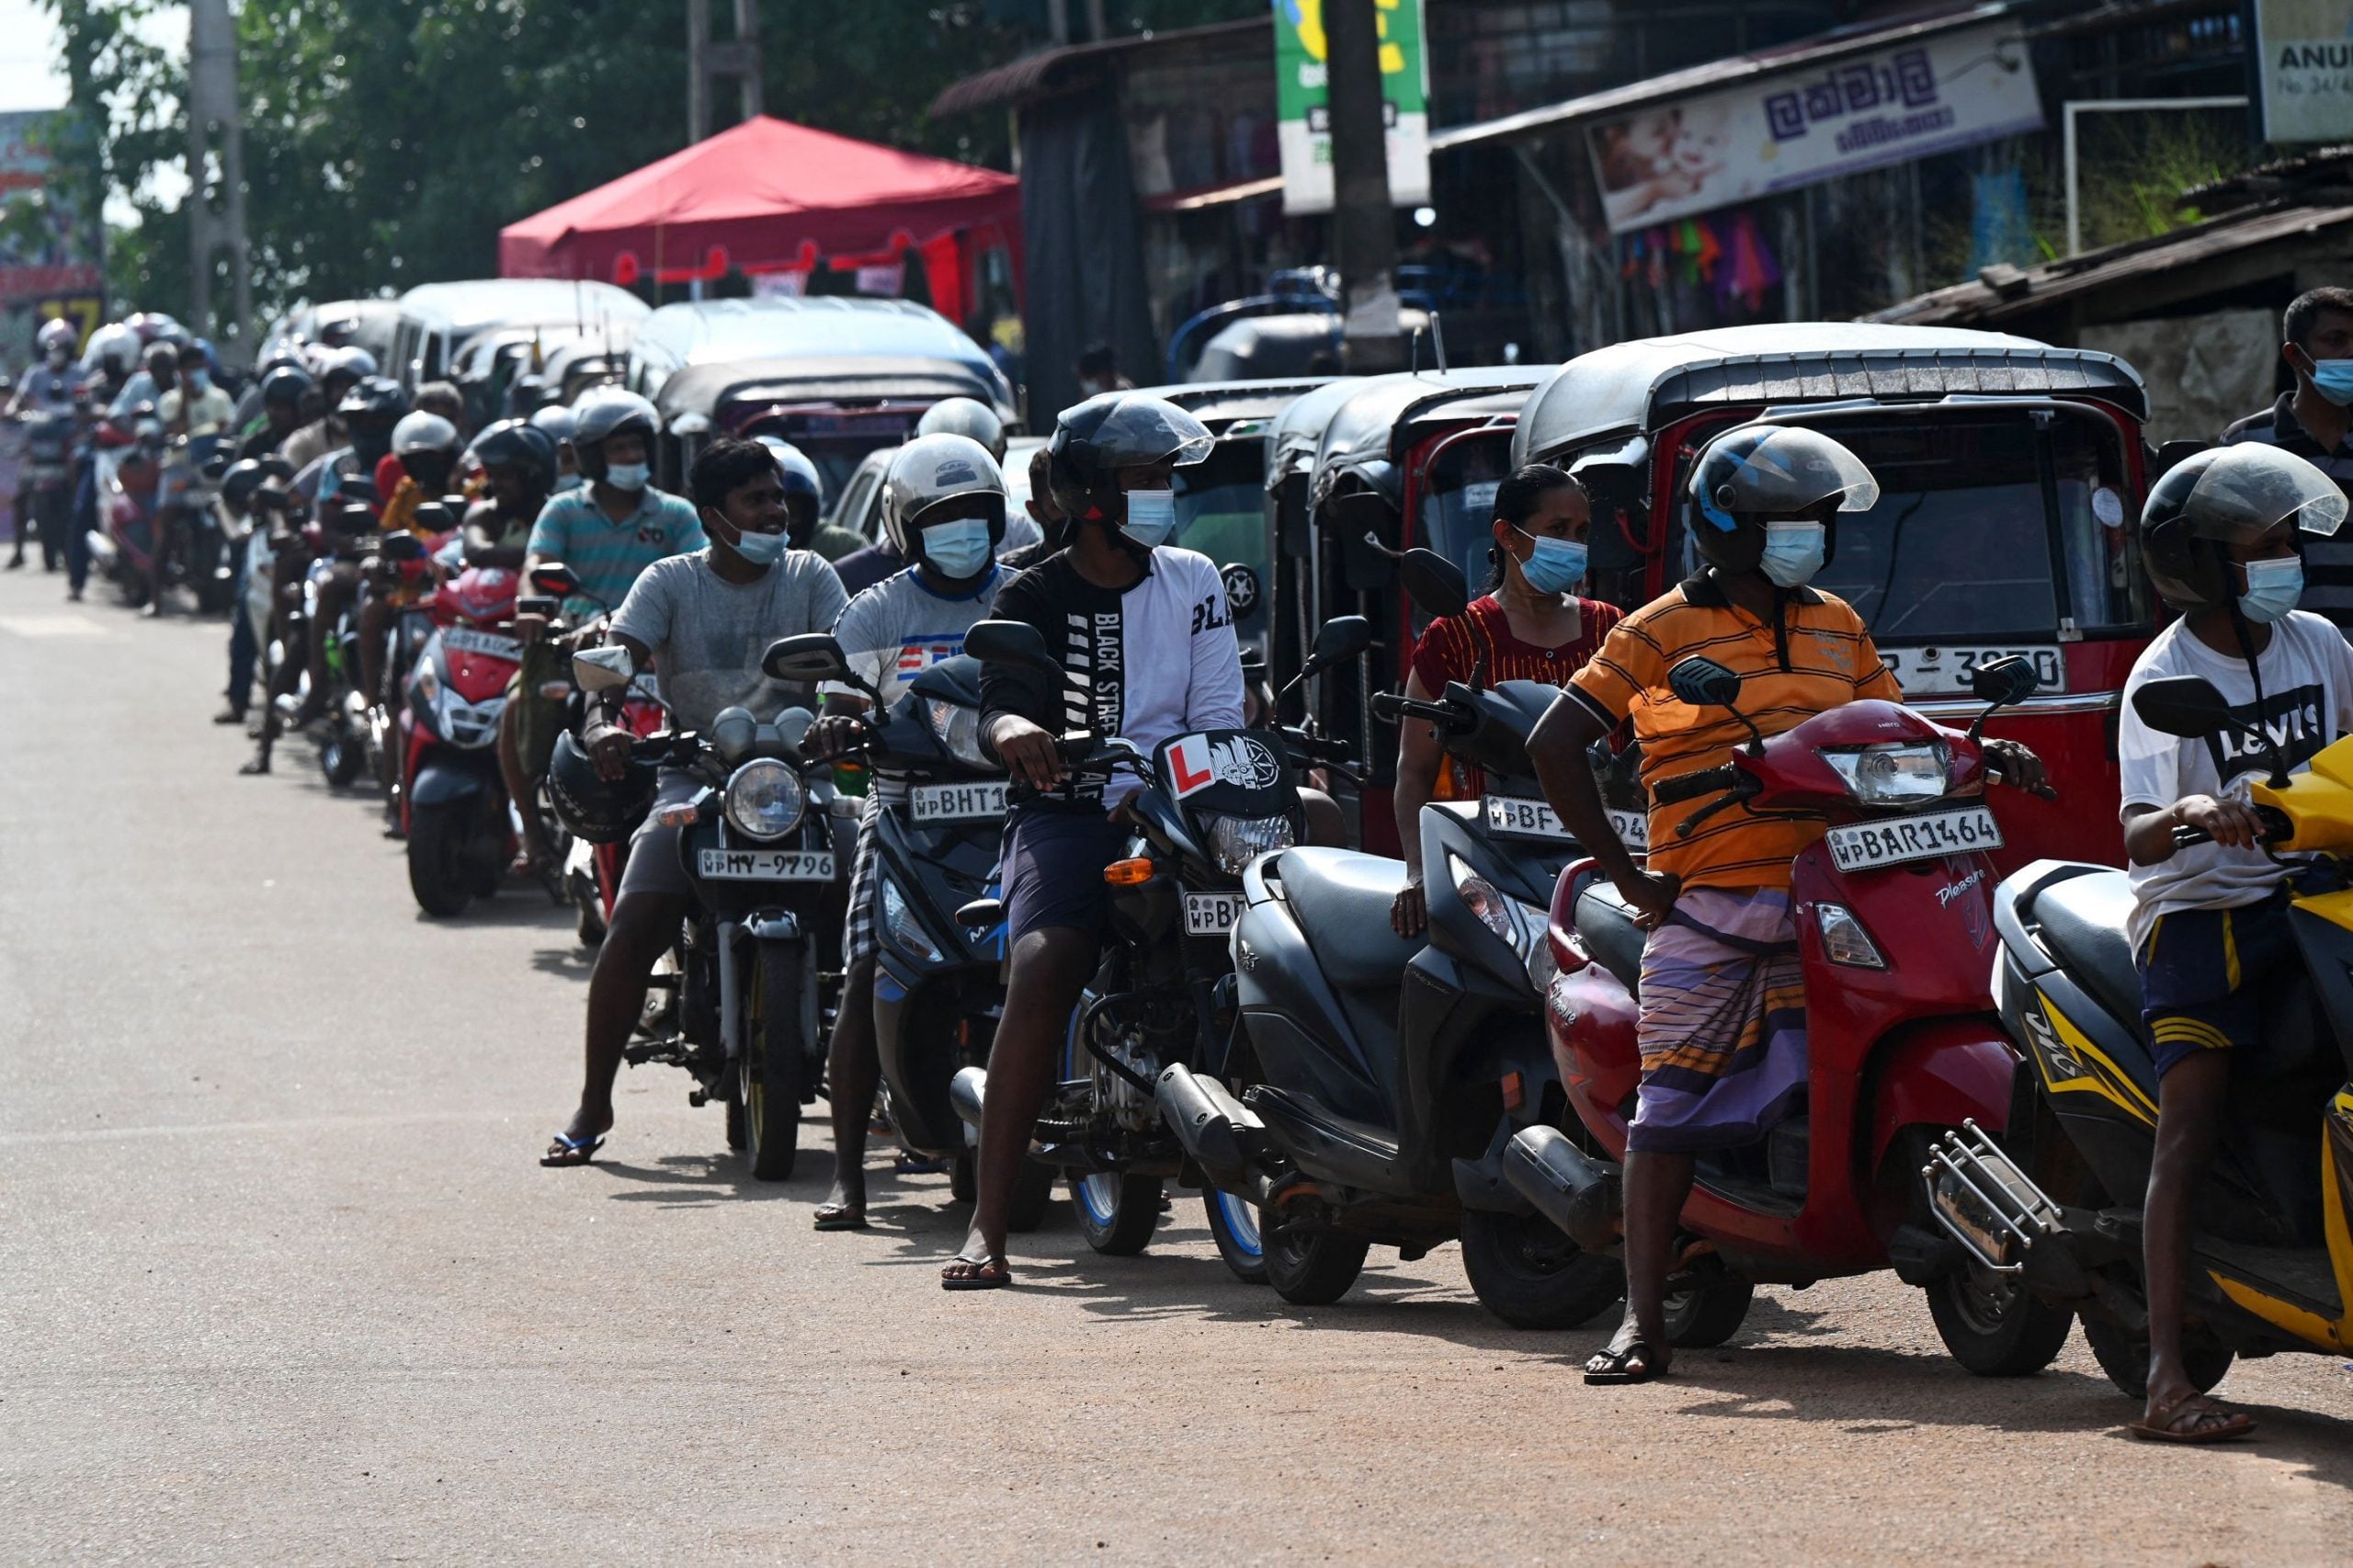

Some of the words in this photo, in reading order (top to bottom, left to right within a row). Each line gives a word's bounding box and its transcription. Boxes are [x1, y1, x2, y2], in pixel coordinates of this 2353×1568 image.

[2279, 45, 2353, 70] ANU
[1095, 613, 1120, 671] BLACK
[1169, 744, 1211, 794] L
[914, 801, 938, 815] WP
[1491, 811, 1517, 827] WP
[1836, 844, 1863, 864] WP
[1860, 813, 1995, 858] BAR1464
[703, 860, 725, 873] WP
[1935, 868, 1985, 909] Pleasure
[1191, 912, 1214, 927] WP
